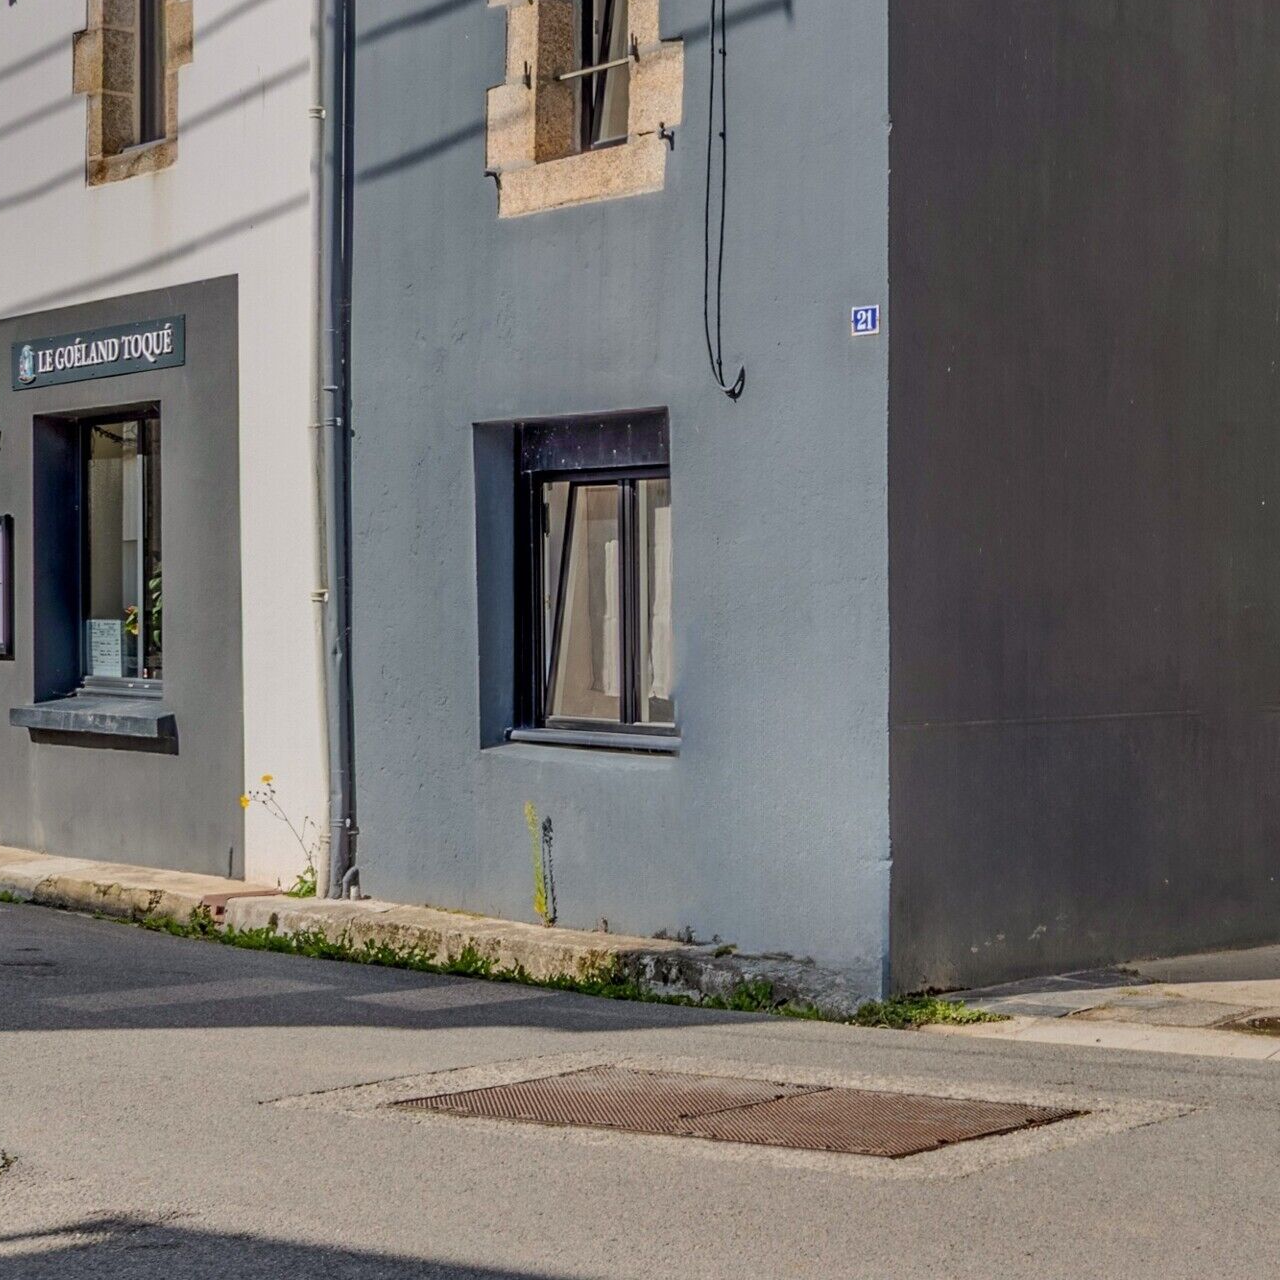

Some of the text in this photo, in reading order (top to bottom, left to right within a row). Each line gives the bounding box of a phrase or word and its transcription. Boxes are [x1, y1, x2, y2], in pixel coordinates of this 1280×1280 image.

[856, 310, 872, 330] 21
[38, 324, 172, 372] LE GOÉLAND TOQUÉ
